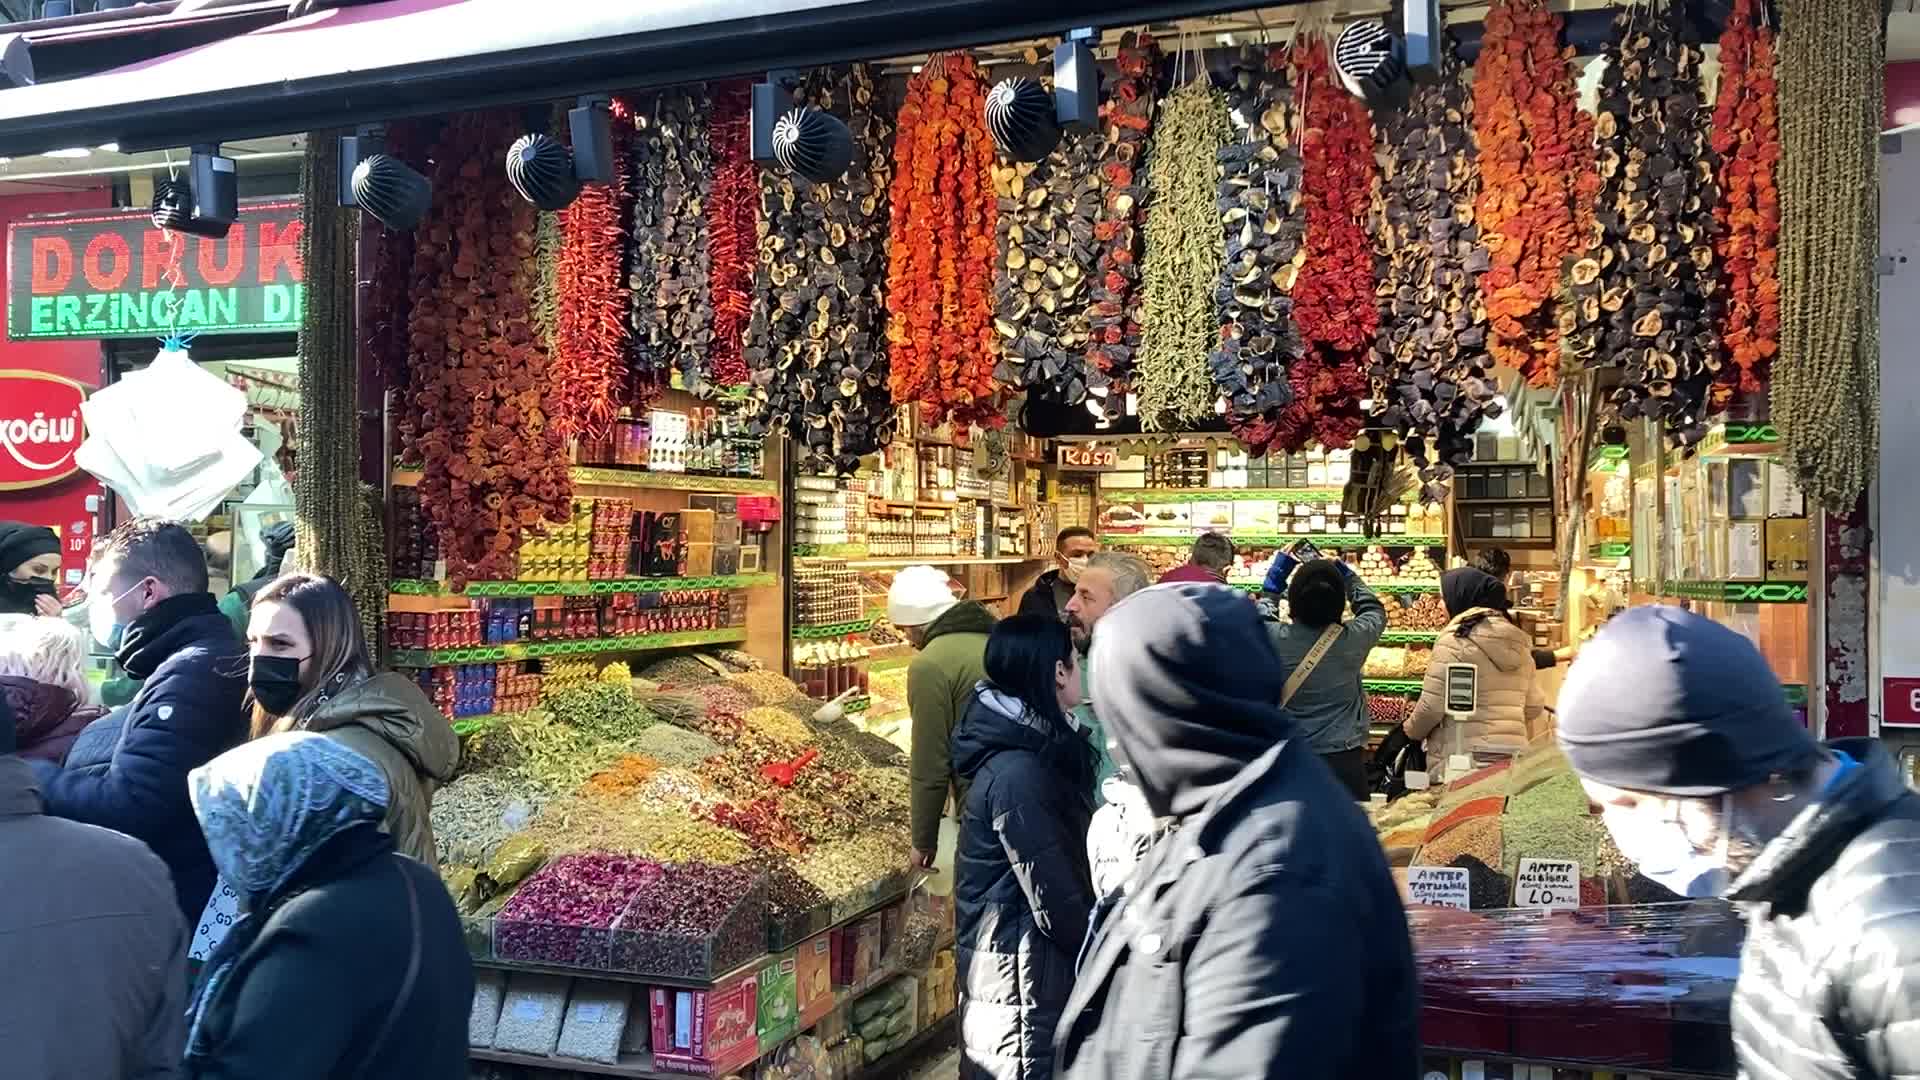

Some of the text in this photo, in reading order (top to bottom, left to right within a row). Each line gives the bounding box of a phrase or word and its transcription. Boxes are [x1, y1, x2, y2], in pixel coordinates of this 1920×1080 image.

[31, 222, 303, 293] DORUK
[1066, 449, 1113, 465] Kasa
[1417, 870, 1463, 880] ANTEP
[1528, 862, 1572, 872] ANTEP
[761, 963, 780, 986] TEA
